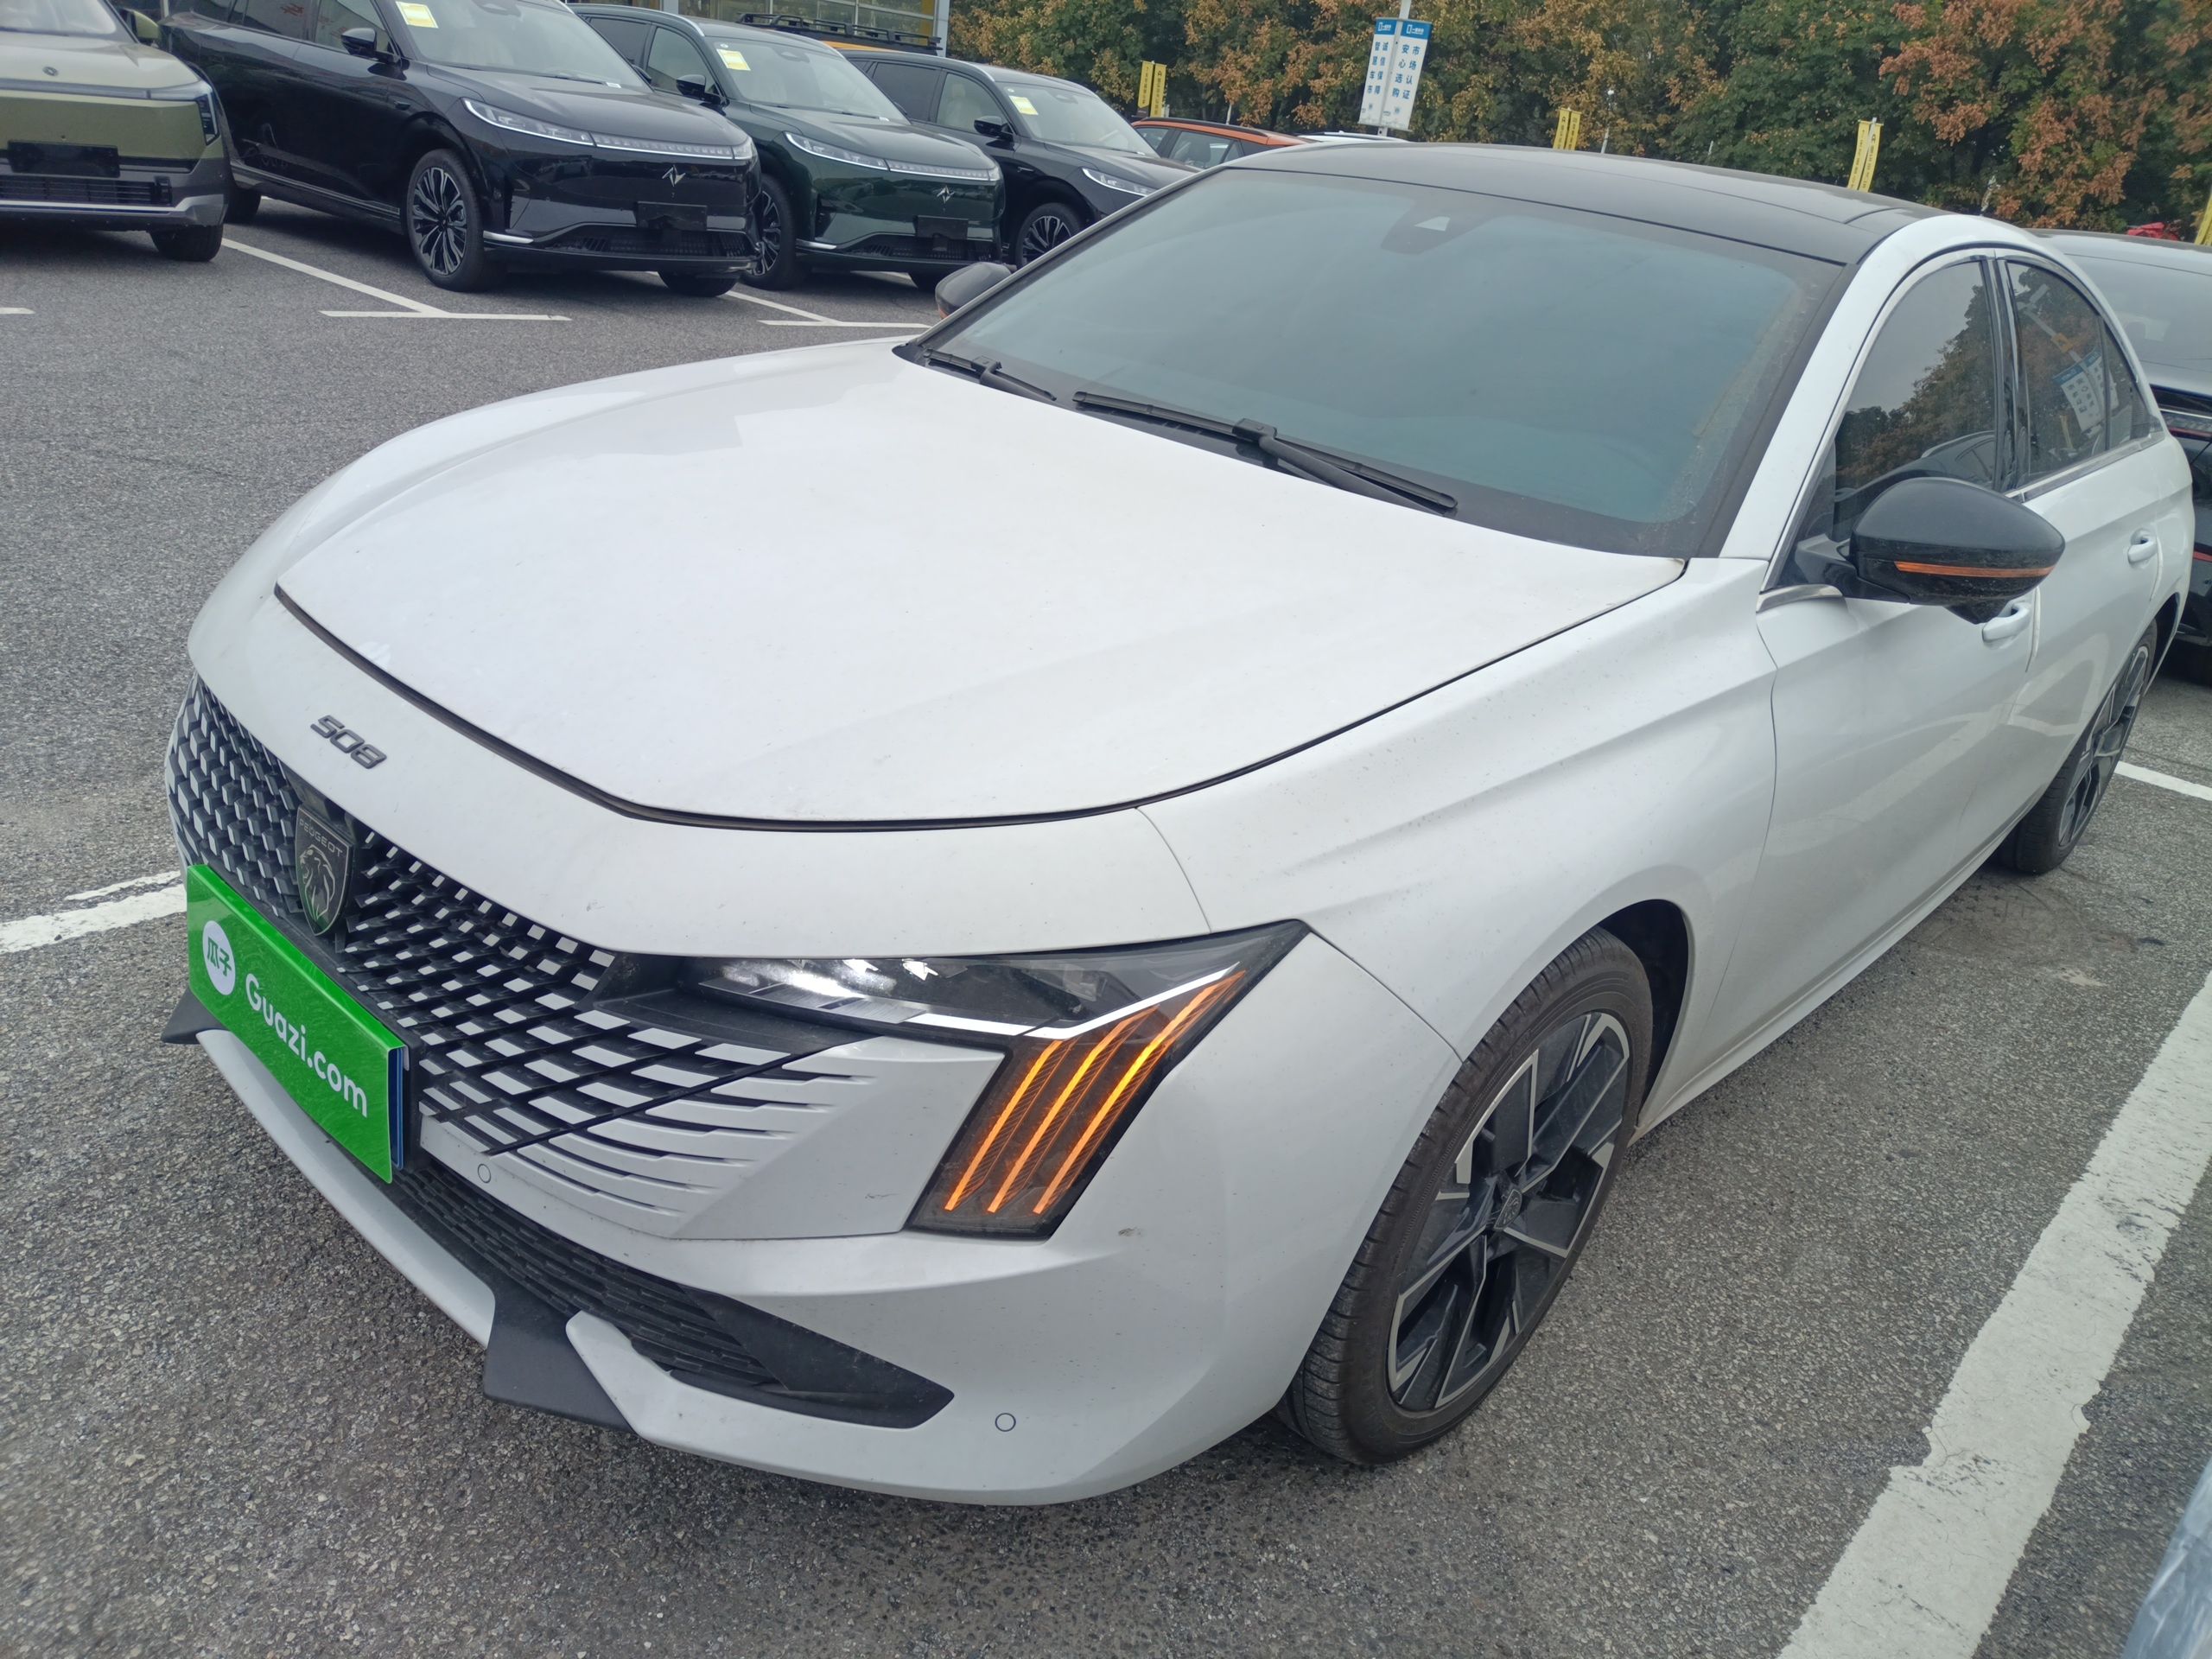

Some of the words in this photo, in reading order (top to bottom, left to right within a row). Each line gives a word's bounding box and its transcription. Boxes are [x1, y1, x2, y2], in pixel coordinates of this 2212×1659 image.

[1392, 44, 1409, 98] 安心选购
[1402, 46, 1420, 99] 市场认证
[310, 715, 387, 769] 508
[299, 818, 343, 857] PEUGEOT
[207, 937, 232, 977] 瓜子
[245, 973, 367, 1118] Guazi.com
